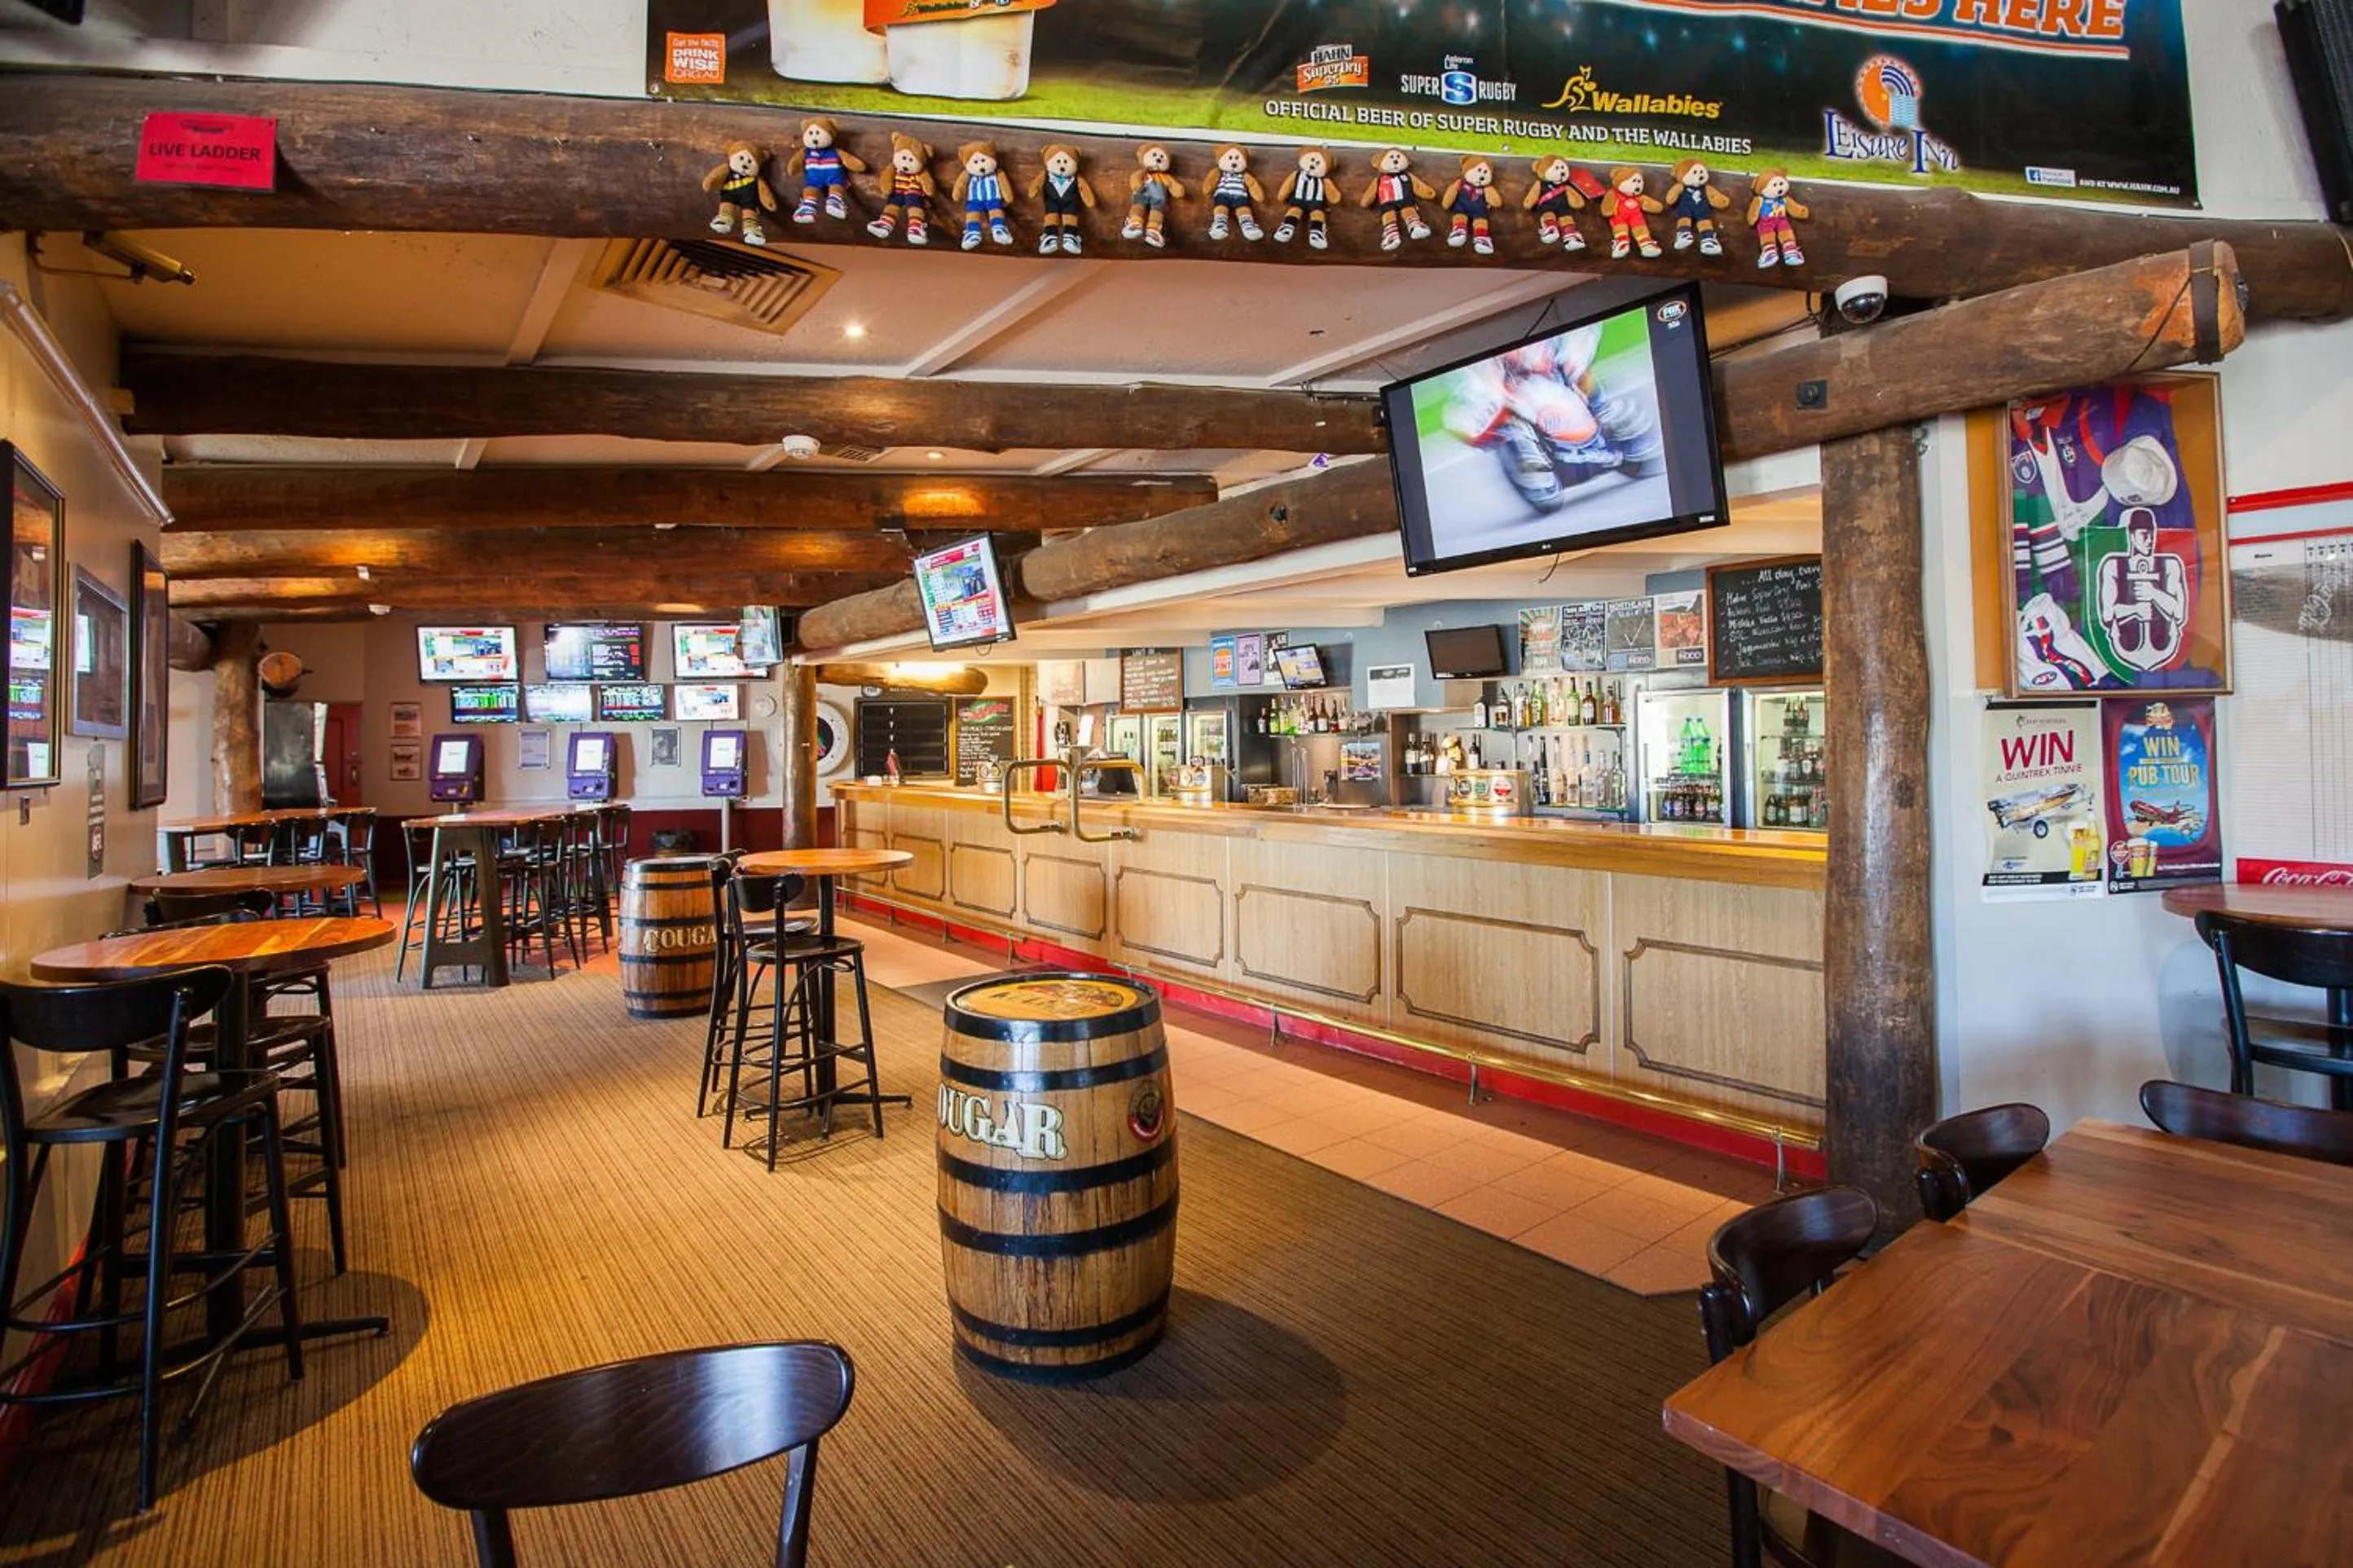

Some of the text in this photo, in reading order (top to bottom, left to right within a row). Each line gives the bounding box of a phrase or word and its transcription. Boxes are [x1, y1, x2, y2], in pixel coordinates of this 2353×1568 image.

[673, 48, 719, 59] DRINK
[673, 57, 719, 71] WISE
[1313, 48, 1350, 63] HAHN
[1401, 74, 1440, 95] SUPER
[1479, 80, 1517, 101] RUGBY
[1592, 90, 1721, 119] Wallabies
[1265, 100, 1752, 154] OFFICIAL BEER OF SUPER RUGBY AND THE WALLABIES
[149, 143, 262, 161] LIVE LADDER
[2000, 730, 2074, 771] WIN
[2143, 736, 2179, 757] WIN
[1995, 775, 2003, 783] A
[2129, 764, 2199, 787] PUB TOUR
[2263, 867, 2353, 885] Coca-C
[644, 925, 718, 953] COUGA
[938, 1083, 1069, 1160] OUGAR
